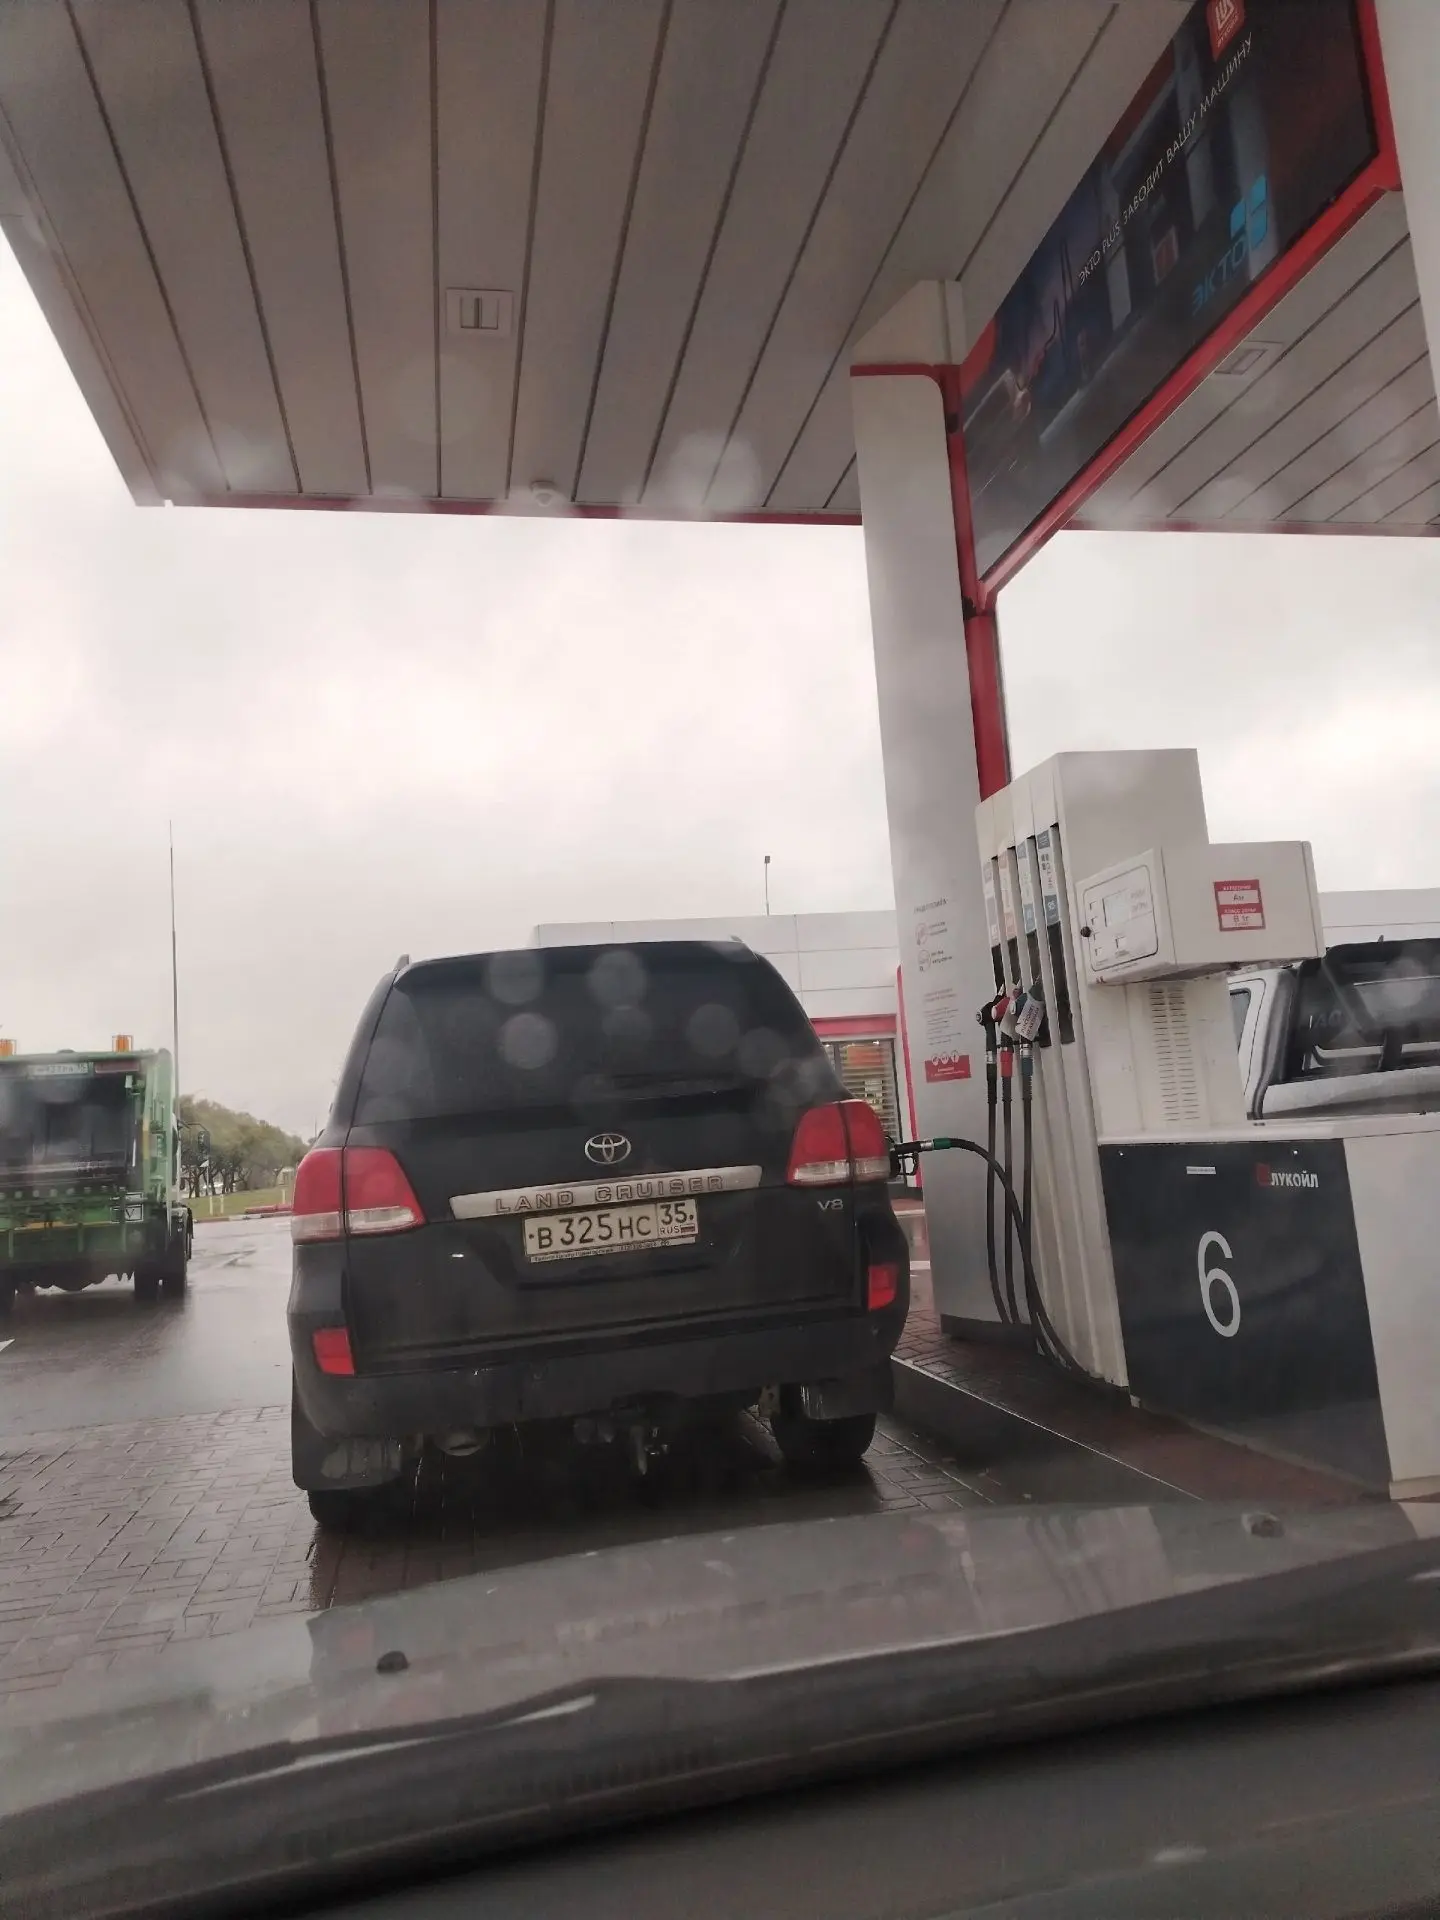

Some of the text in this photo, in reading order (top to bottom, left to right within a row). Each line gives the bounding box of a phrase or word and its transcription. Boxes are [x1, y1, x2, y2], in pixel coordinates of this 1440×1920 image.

[1080, 251, 1101, 286] ЭКТО
[1102, 221, 1120, 254] PLUS
[1123, 158, 1164, 225] ЗАВОДИТ
[1166, 111, 1197, 163] ВАШУ
[1200, 31, 1252, 118] МАШИНУ
[495, 1175, 725, 1214] LAND CRUISER
[1271, 1170, 1319, 1188] ЛУКОЙЛ
[817, 1198, 844, 1211] V8
[1197, 1230, 1241, 1338] 6
